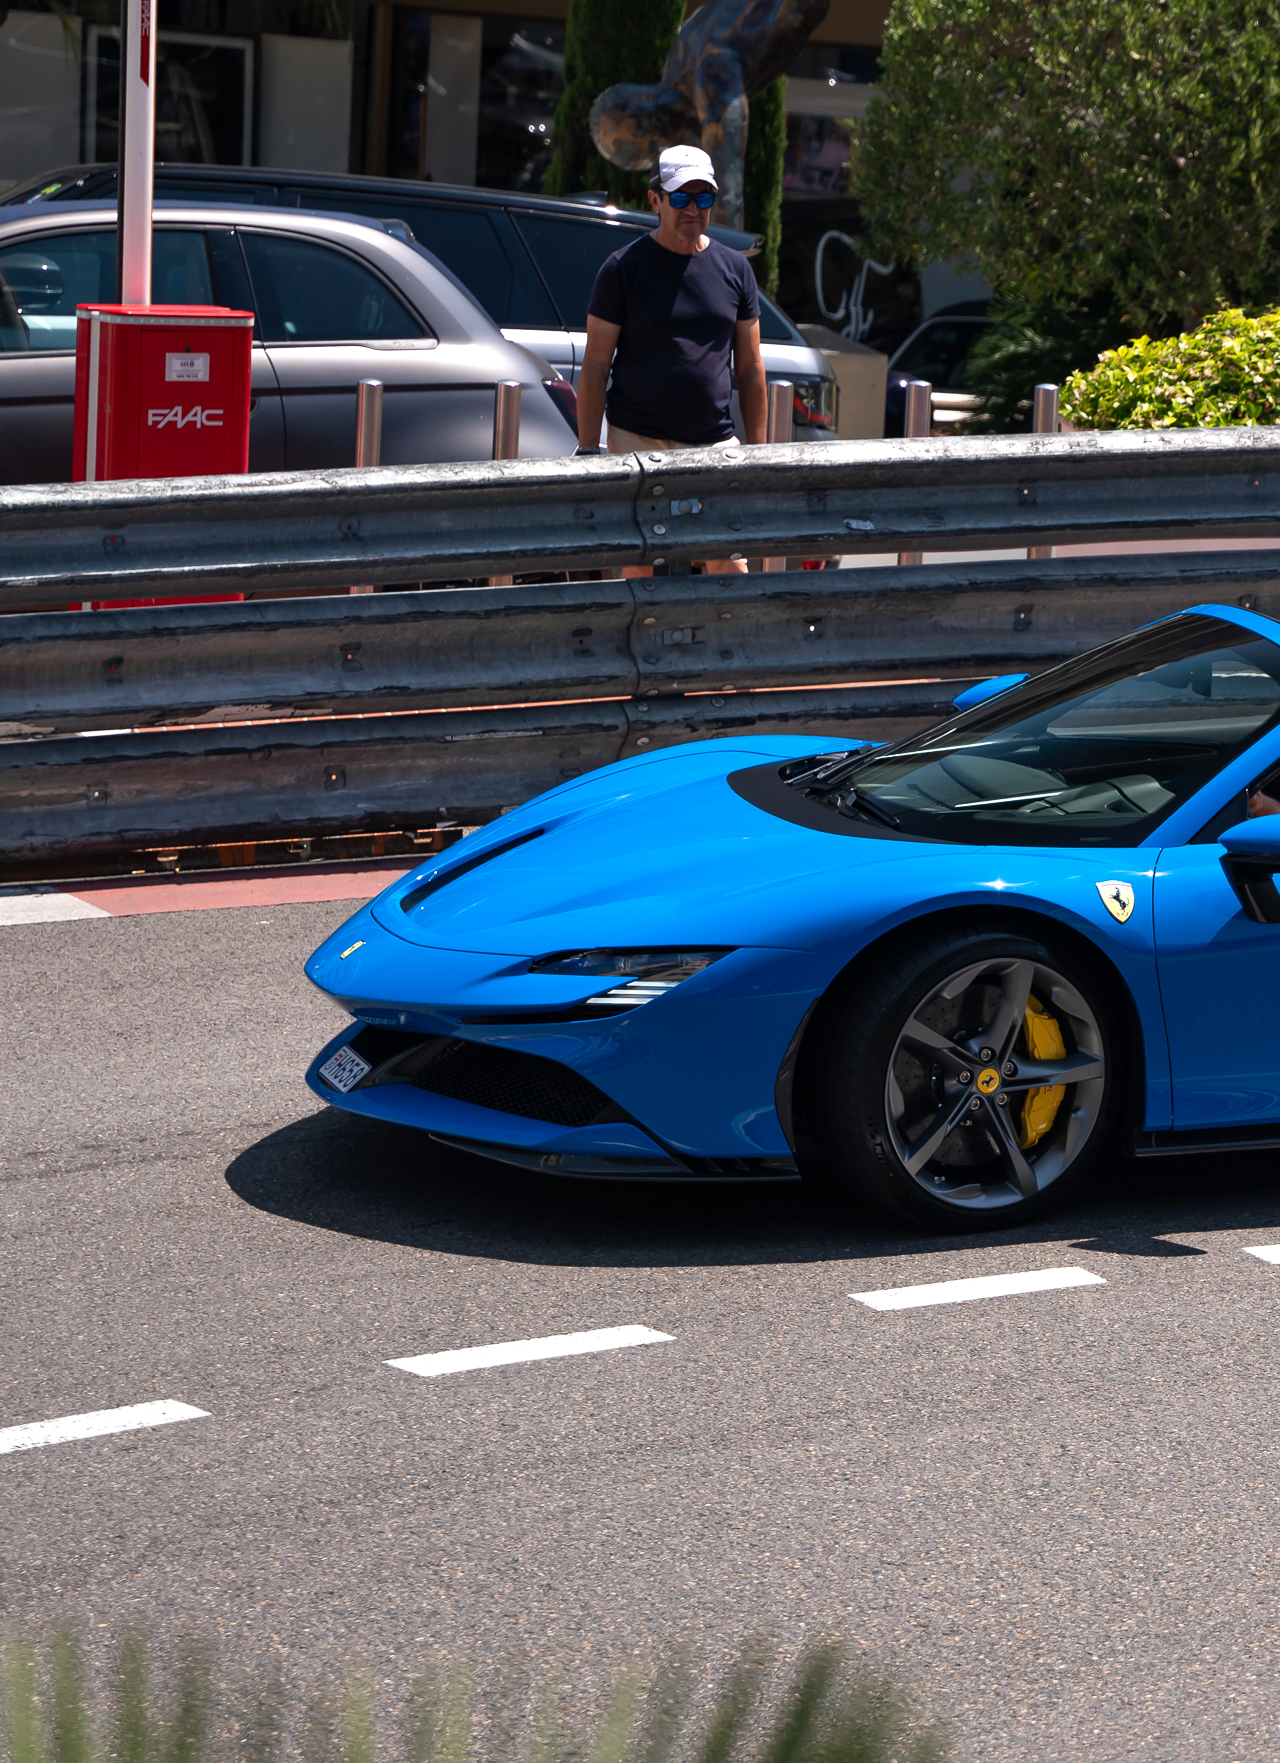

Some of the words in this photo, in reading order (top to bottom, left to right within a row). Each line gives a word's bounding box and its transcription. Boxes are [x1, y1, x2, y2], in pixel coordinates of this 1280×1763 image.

[142, 0, 150, 36] FAAC
[147, 405, 224, 429] FAAC
[327, 1053, 366, 1088] H658
